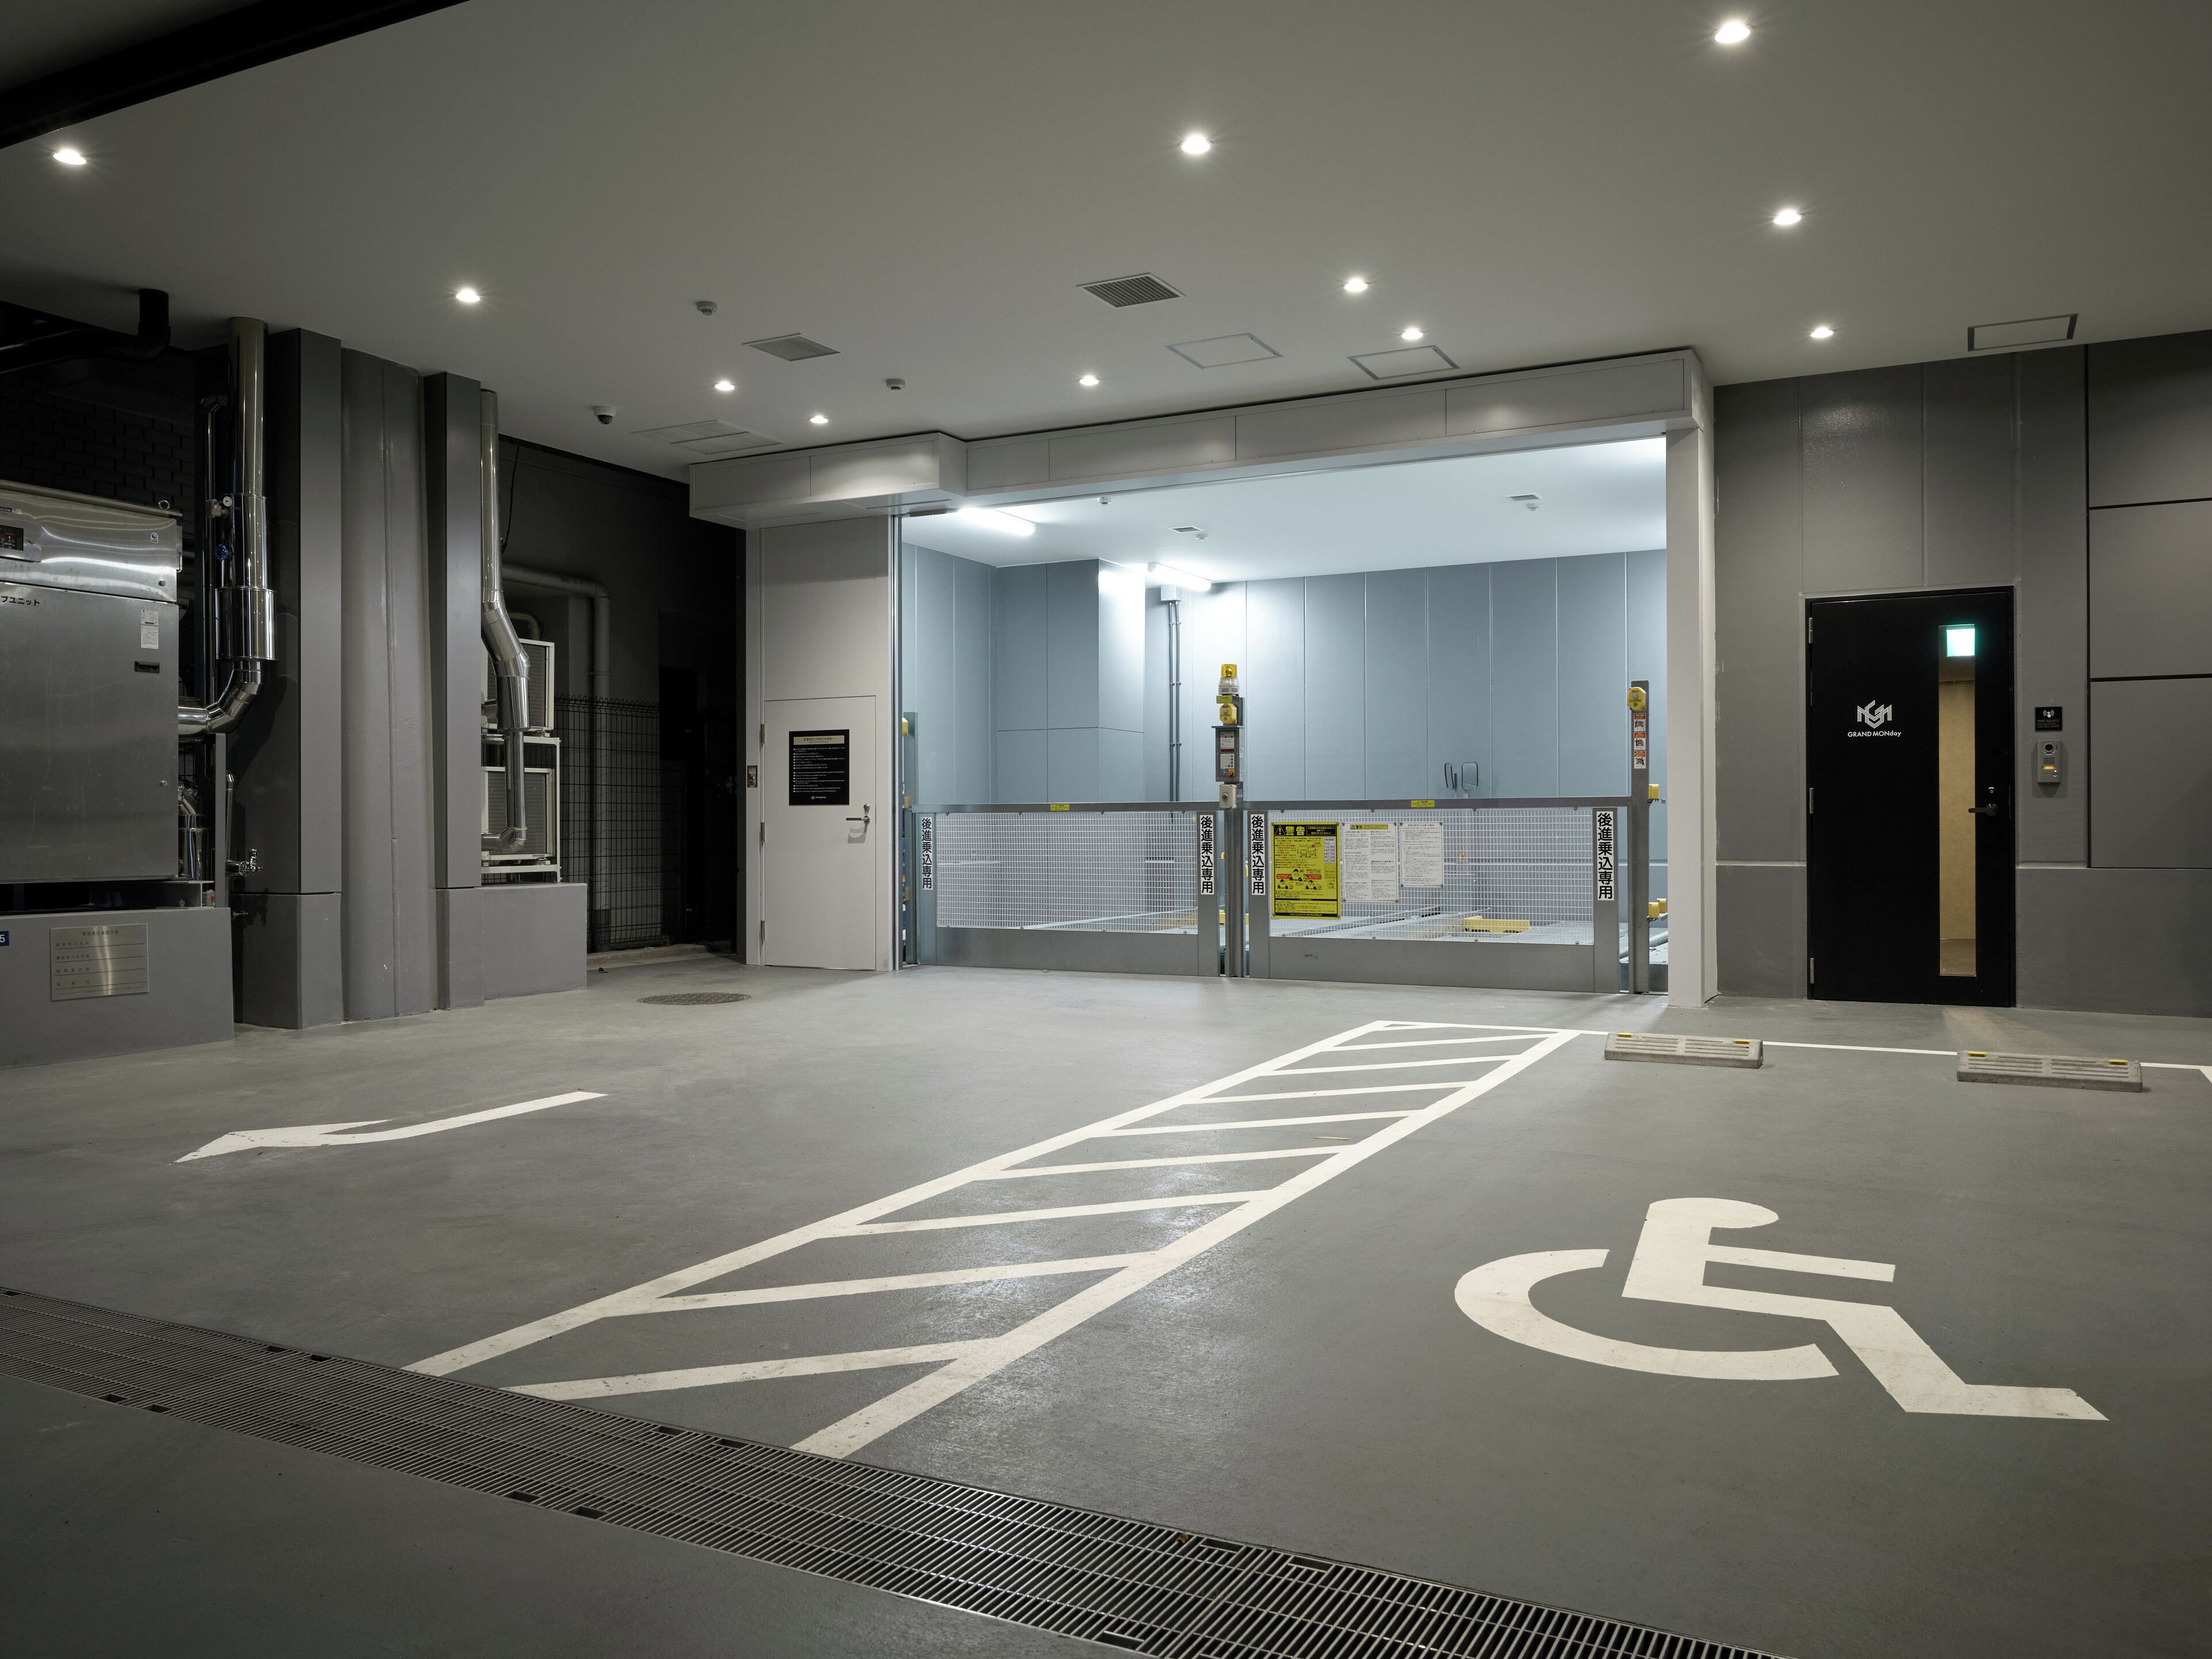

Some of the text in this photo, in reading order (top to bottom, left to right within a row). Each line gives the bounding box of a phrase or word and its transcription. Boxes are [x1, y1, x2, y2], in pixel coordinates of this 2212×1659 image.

[922, 817, 933, 889] 後進乗込専用
[1200, 816, 1213, 894] 後進乗込専用
[1251, 815, 1264, 894] 後進乗込専用
[1285, 825, 1305, 836] 警告
[1597, 812, 1613, 899] 後進乗込専用
